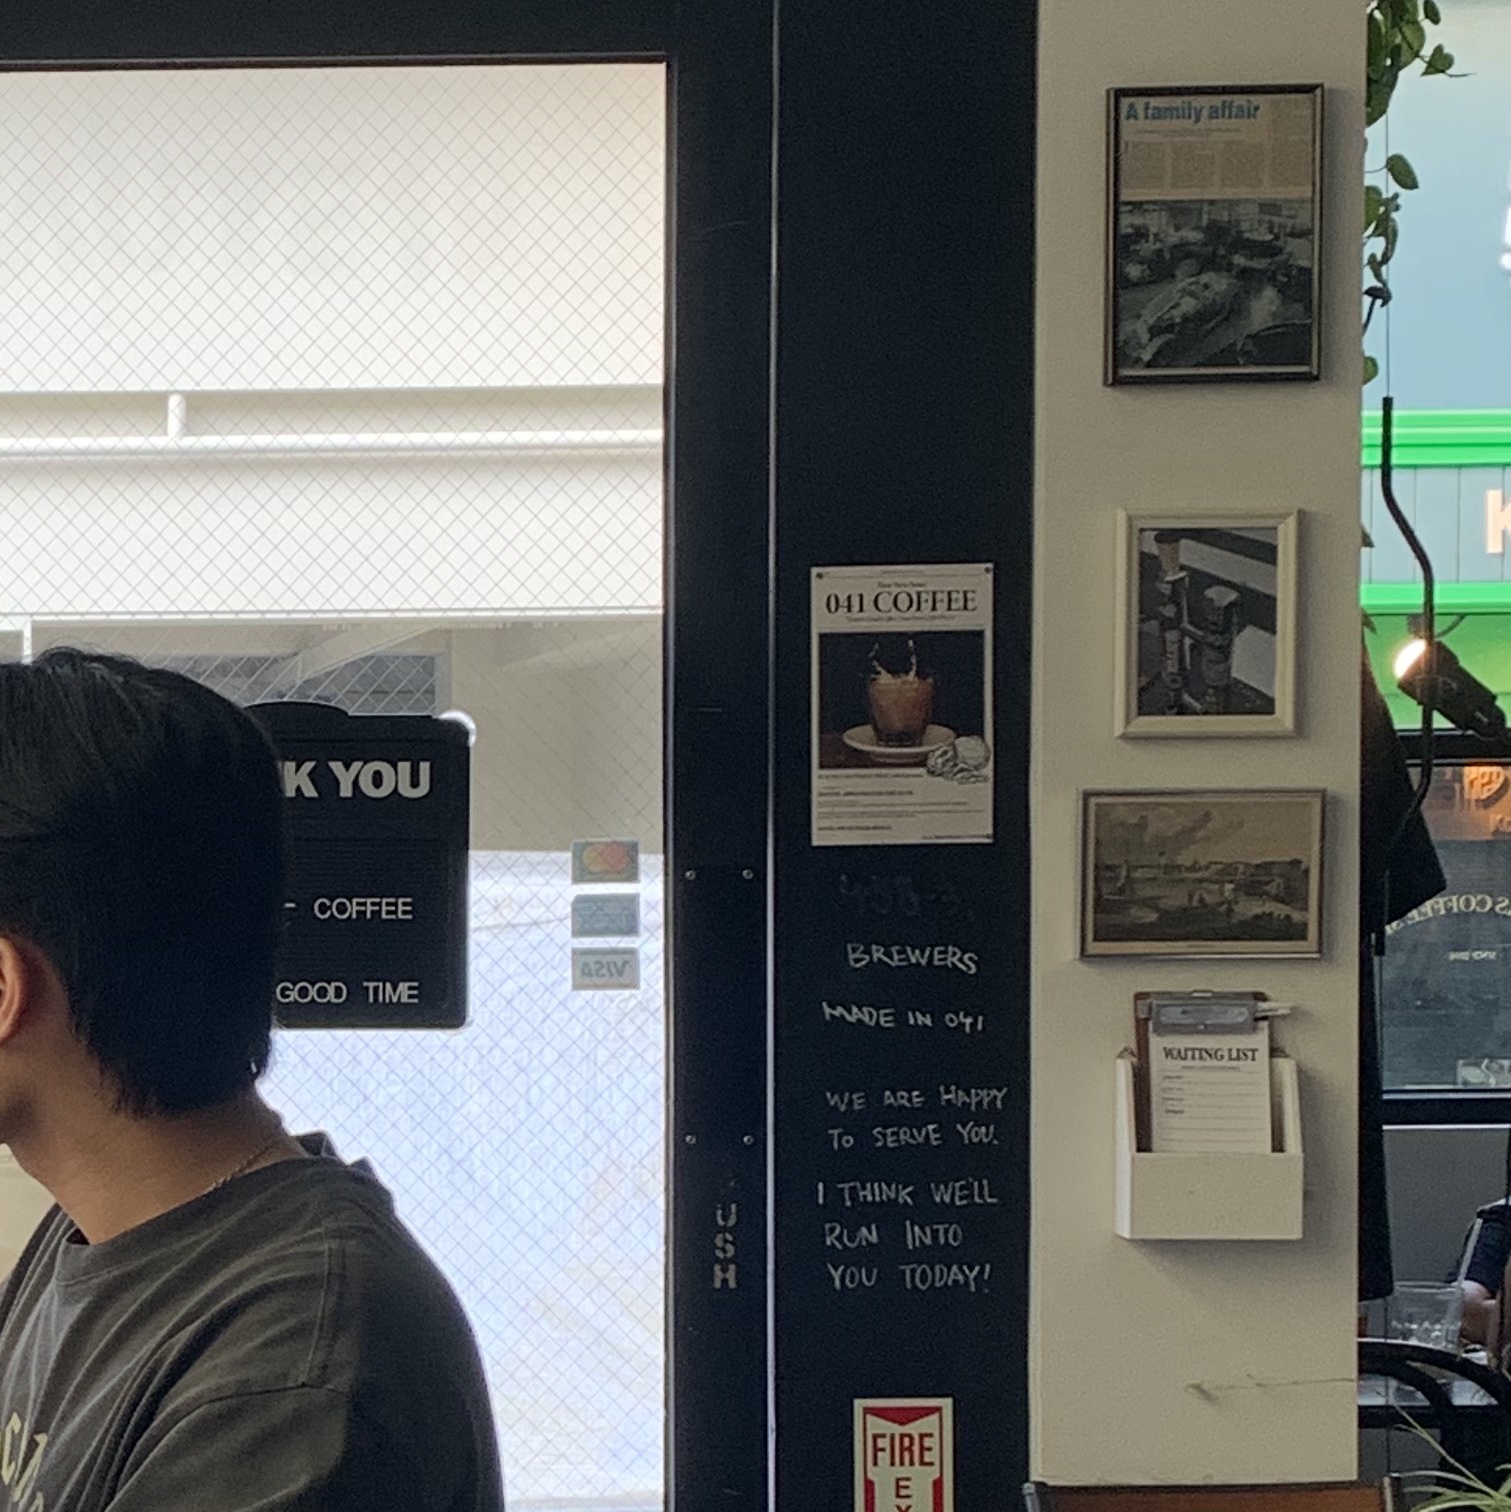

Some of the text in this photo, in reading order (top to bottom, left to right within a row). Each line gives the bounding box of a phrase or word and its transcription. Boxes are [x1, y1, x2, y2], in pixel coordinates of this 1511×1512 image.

[1125, 100, 1260, 124] A family affair
[825, 590, 978, 615] 041 COFFEE
[327, 760, 431, 799] YOU
[313, 898, 413, 919] COFFEE
[846, 943, 979, 975] BREWERS
[275, 982, 420, 1003] GOOD TIME
[822, 1001, 896, 1028] MADE
[907, 1010, 934, 1027] IN
[1162, 1046, 1260, 1062] WAITING LIST
[826, 1085, 1008, 1112] WE ARE HAPPY
[872, 1124, 943, 1148] SERVE
[817, 1181, 825, 1205] I
[838, 1181, 914, 1207] THINK
[713, 1202, 737, 1290] USH
[825, 1219, 963, 1250] RUN INTO
[827, 1263, 991, 1293] YOU TODAY!
[871, 1433, 936, 1468] FIRE
